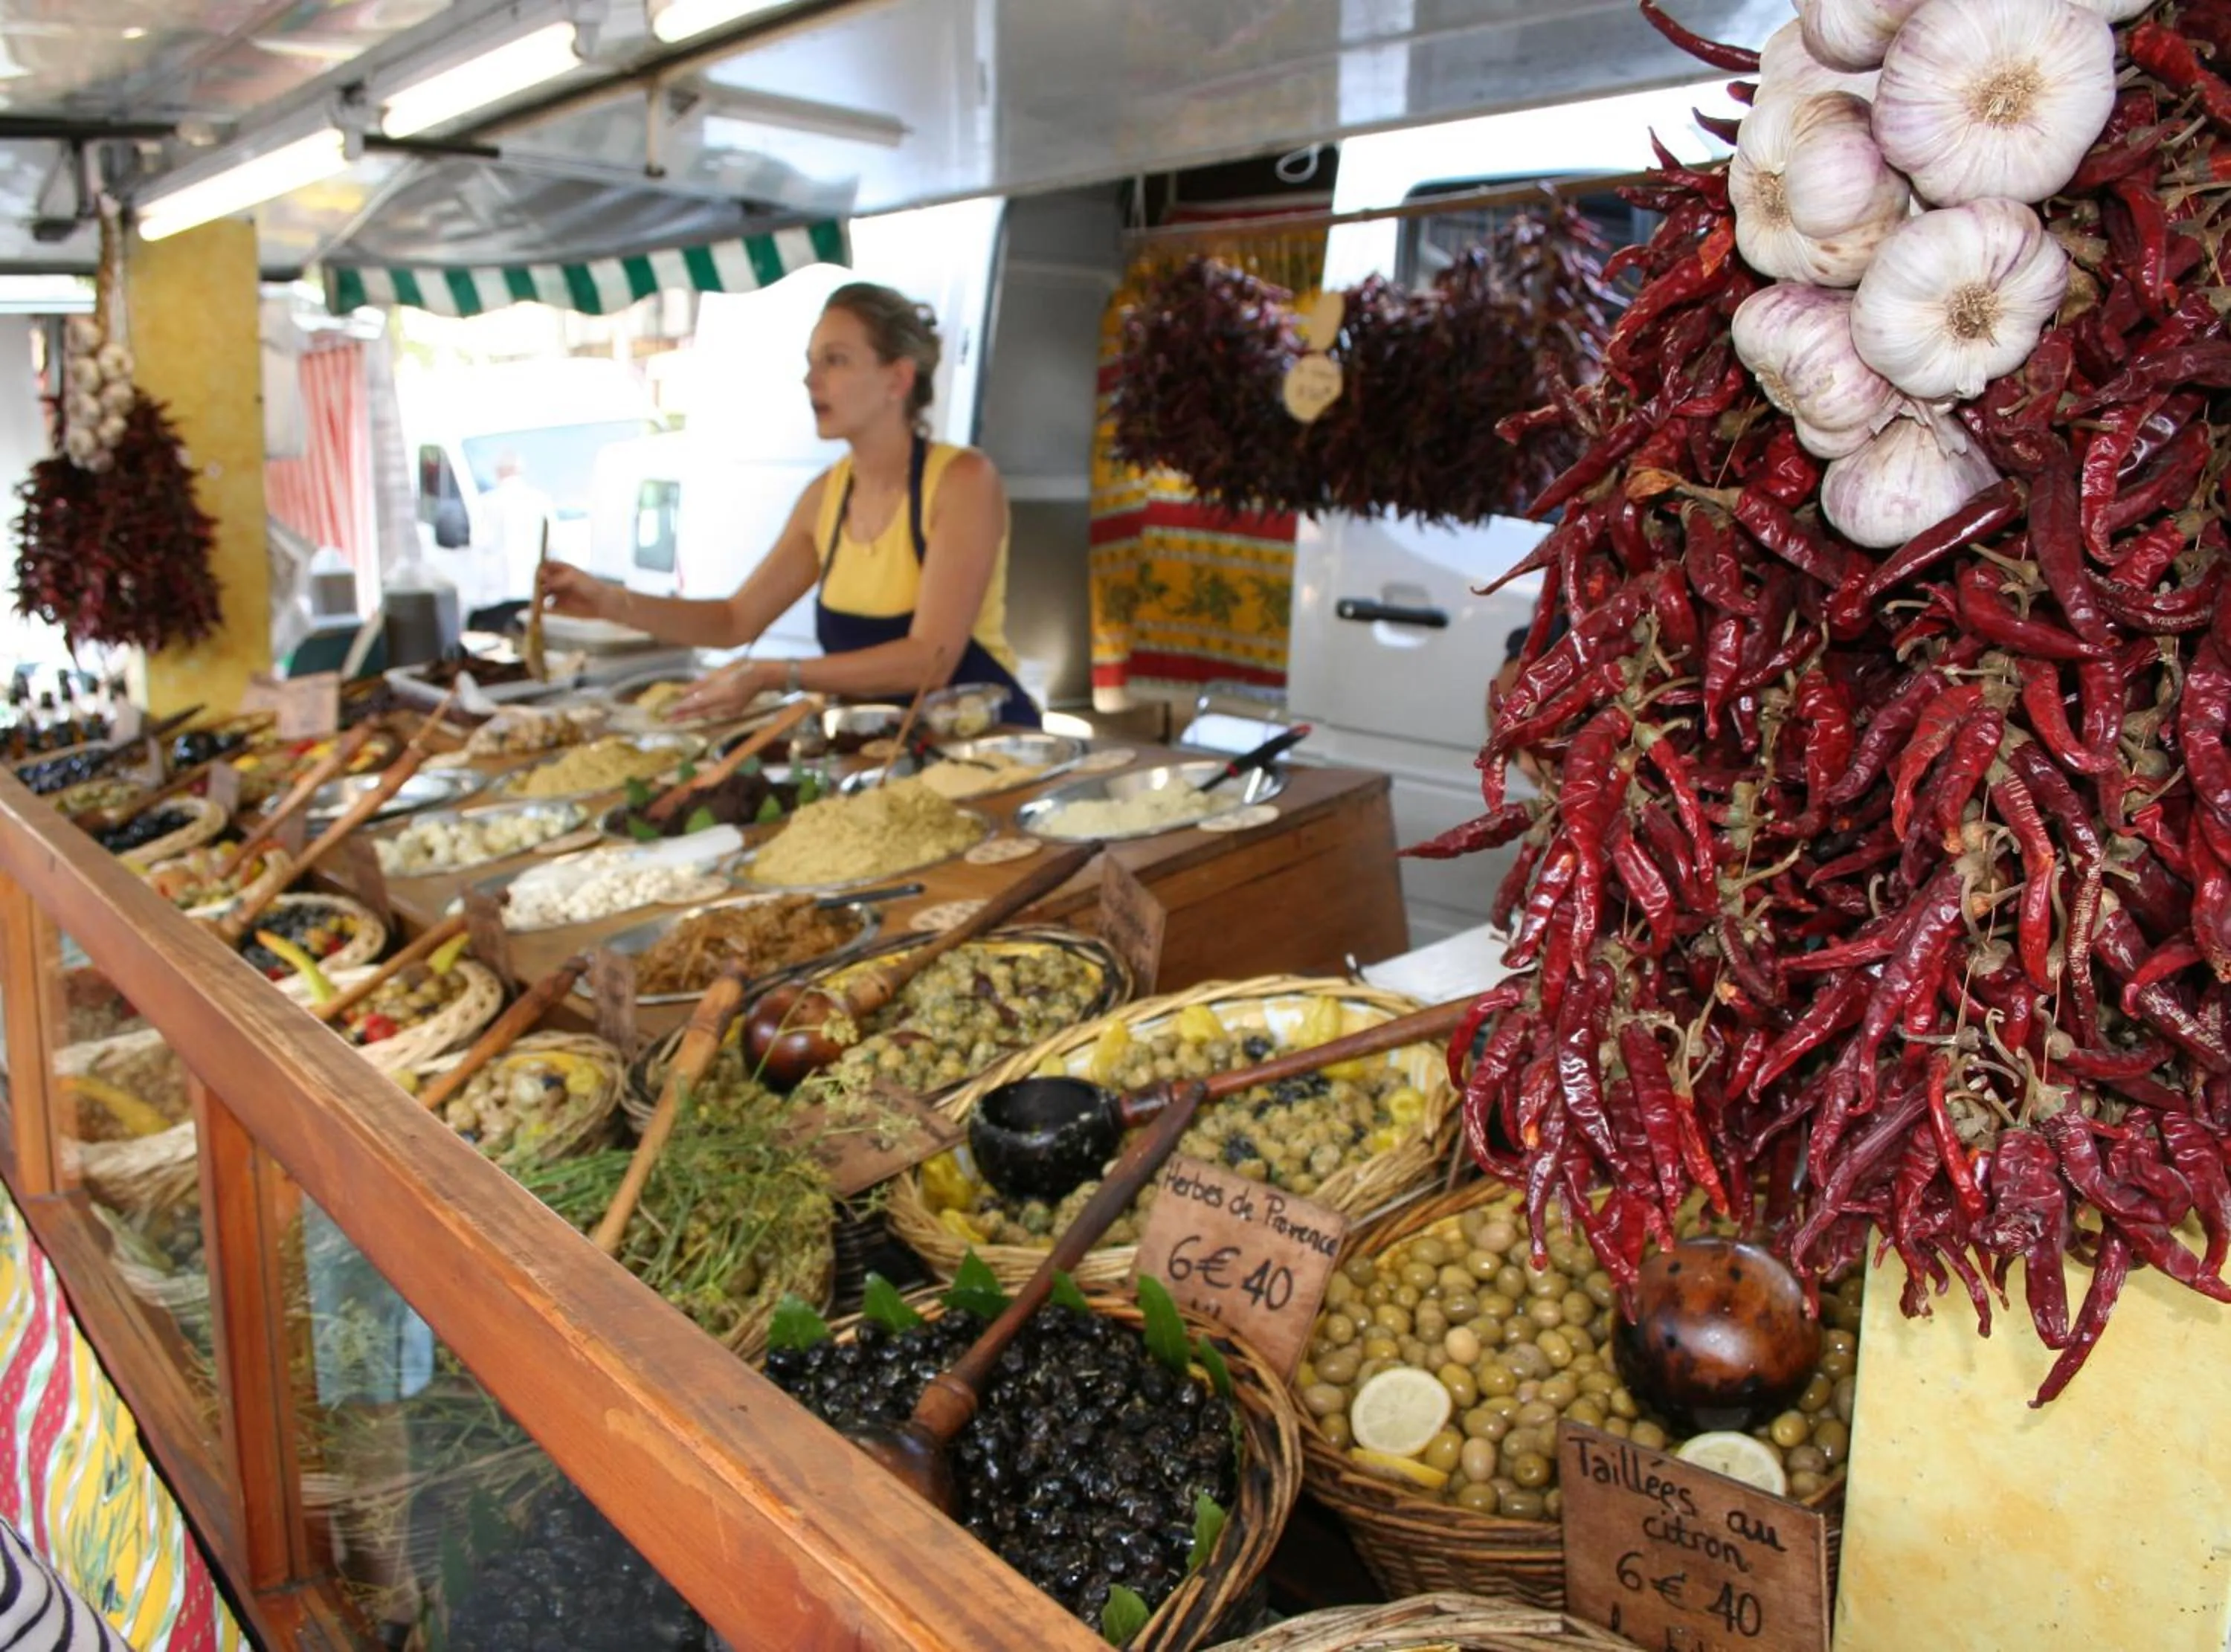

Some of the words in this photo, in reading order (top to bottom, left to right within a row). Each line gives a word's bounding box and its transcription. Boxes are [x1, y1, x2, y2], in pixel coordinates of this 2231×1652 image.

[1165, 1161, 1224, 1210] Herbes
[1229, 1185, 1255, 1222] de
[1264, 1193, 1338, 1258] Provence
[1567, 1436, 1699, 1519] Taillées
[1725, 1510, 1788, 1553] au
[1641, 1508, 1752, 1574] citron
